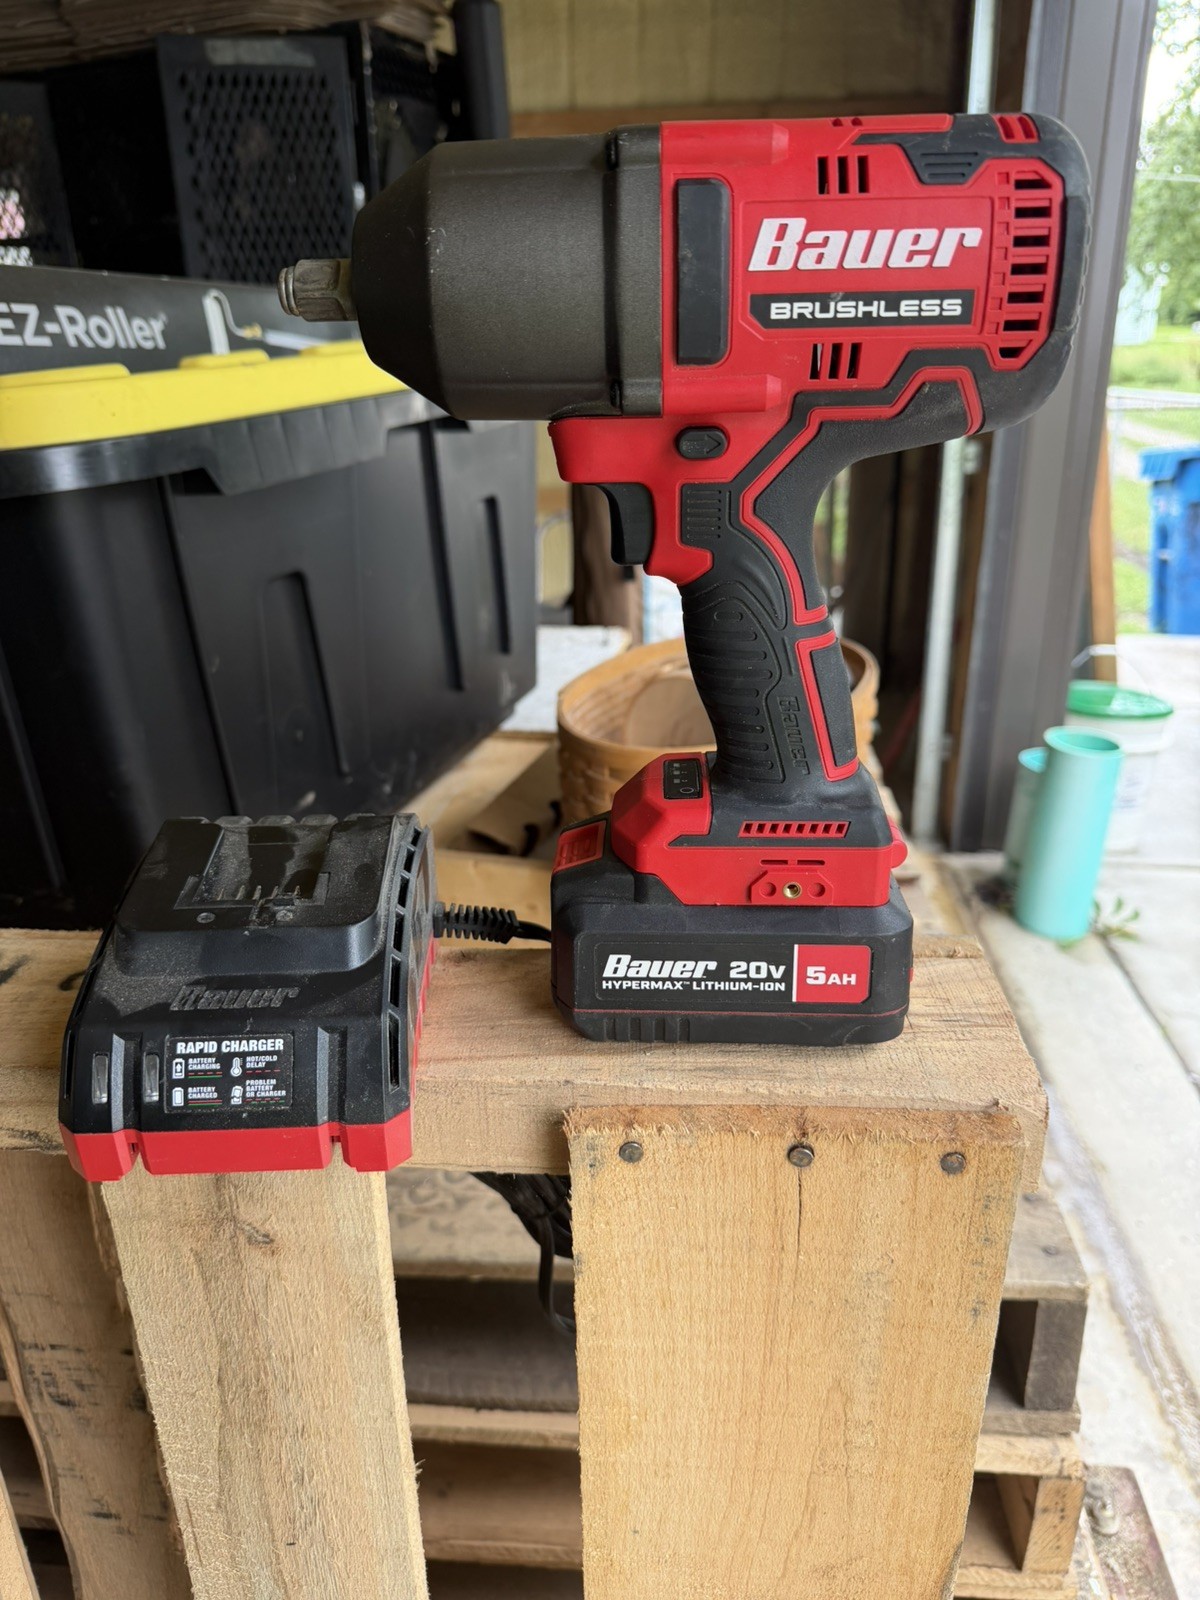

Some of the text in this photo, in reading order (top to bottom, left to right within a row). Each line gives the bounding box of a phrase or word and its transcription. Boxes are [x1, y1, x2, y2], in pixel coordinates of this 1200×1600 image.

[748, 217, 983, 271] Bauer
[769, 298, 963, 320] BRUSHLESS
[777, 695, 811, 776] Bauer
[602, 954, 717, 979] Bauer
[169, 985, 300, 1011] Bauer
[692, 981, 786, 992] LITHIUM-ION
[176, 1038, 284, 1054] RAPID CHARGER
[187, 1092, 218, 1100] CHARGED
